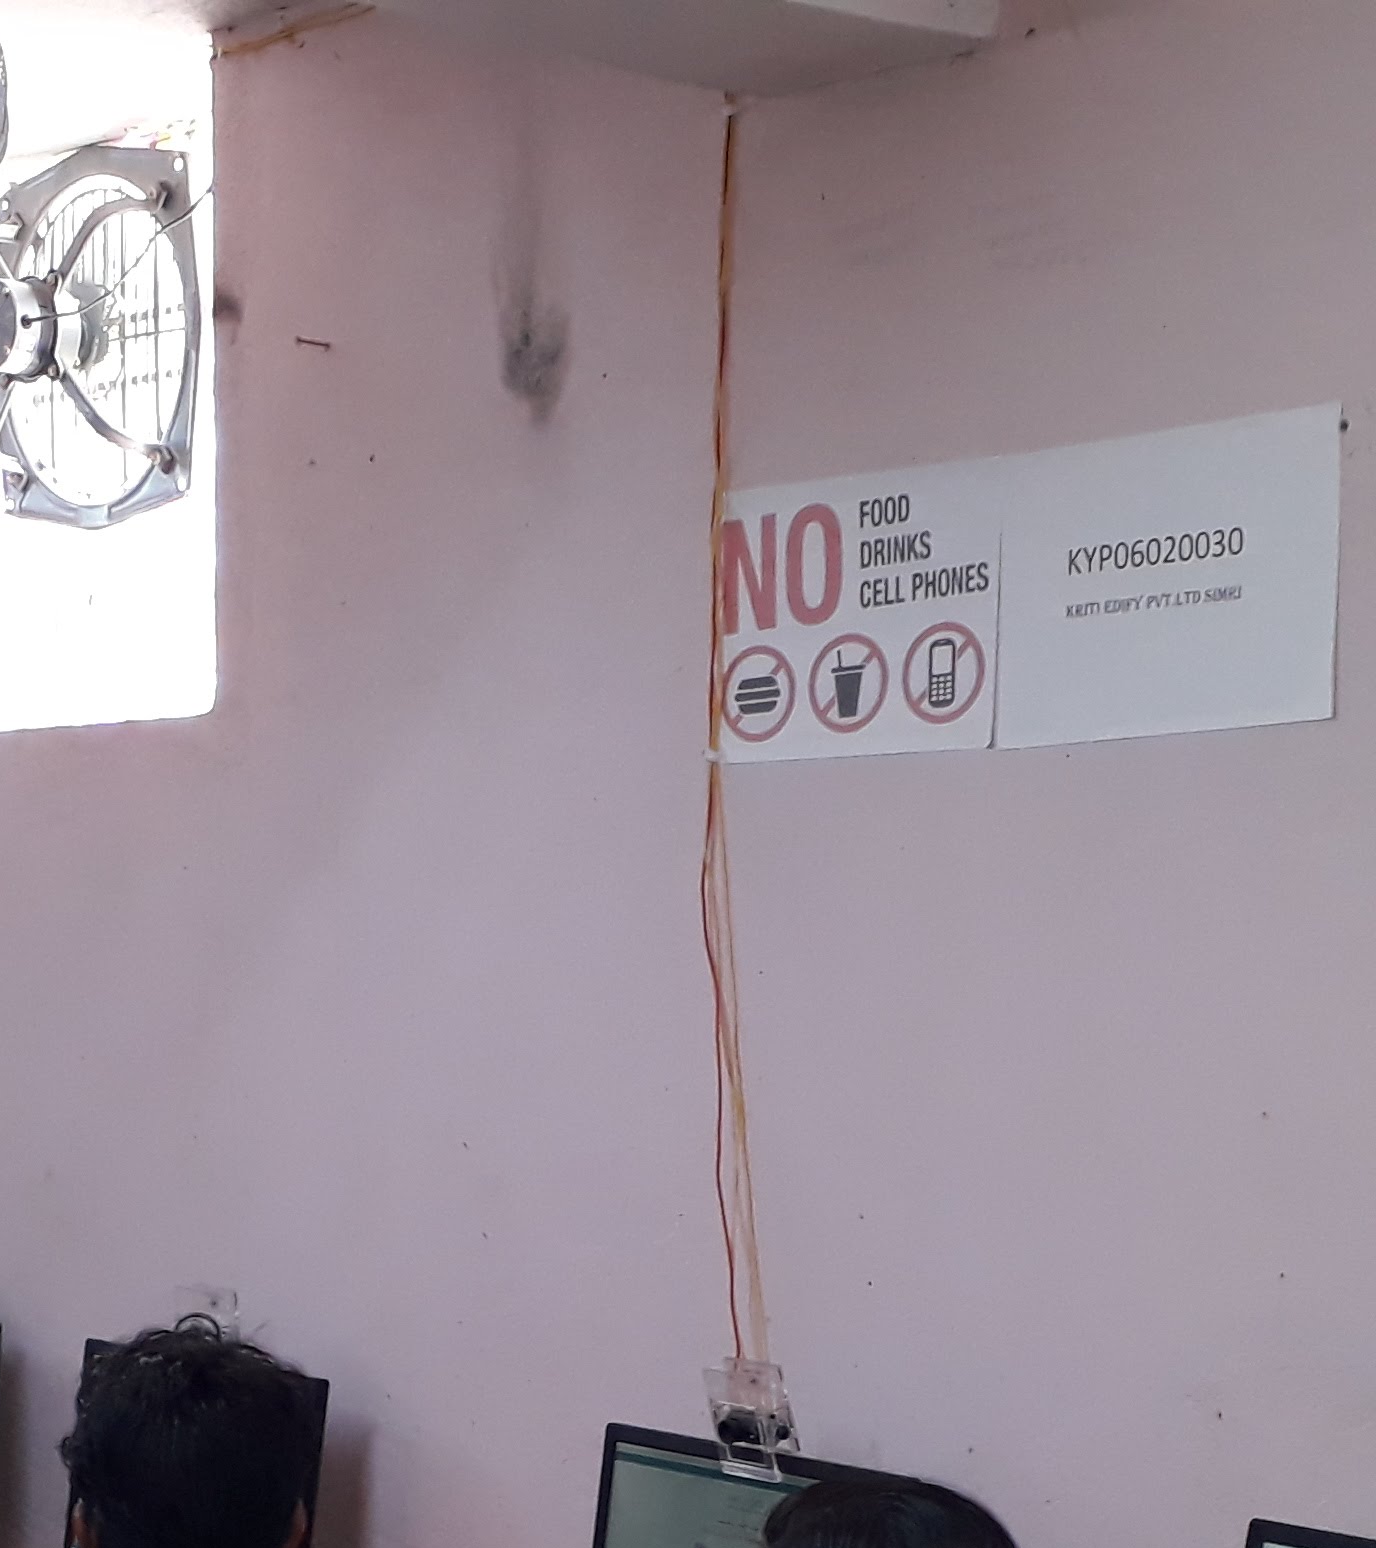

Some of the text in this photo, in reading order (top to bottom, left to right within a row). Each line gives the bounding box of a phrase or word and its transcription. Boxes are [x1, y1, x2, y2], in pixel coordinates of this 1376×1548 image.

[859, 493, 911, 528] FOOD
[723, 502, 843, 636] NO
[859, 530, 932, 569] DRINKS
[1068, 526, 1244, 576] KYP06020030
[859, 562, 990, 609] CELL PHONES
